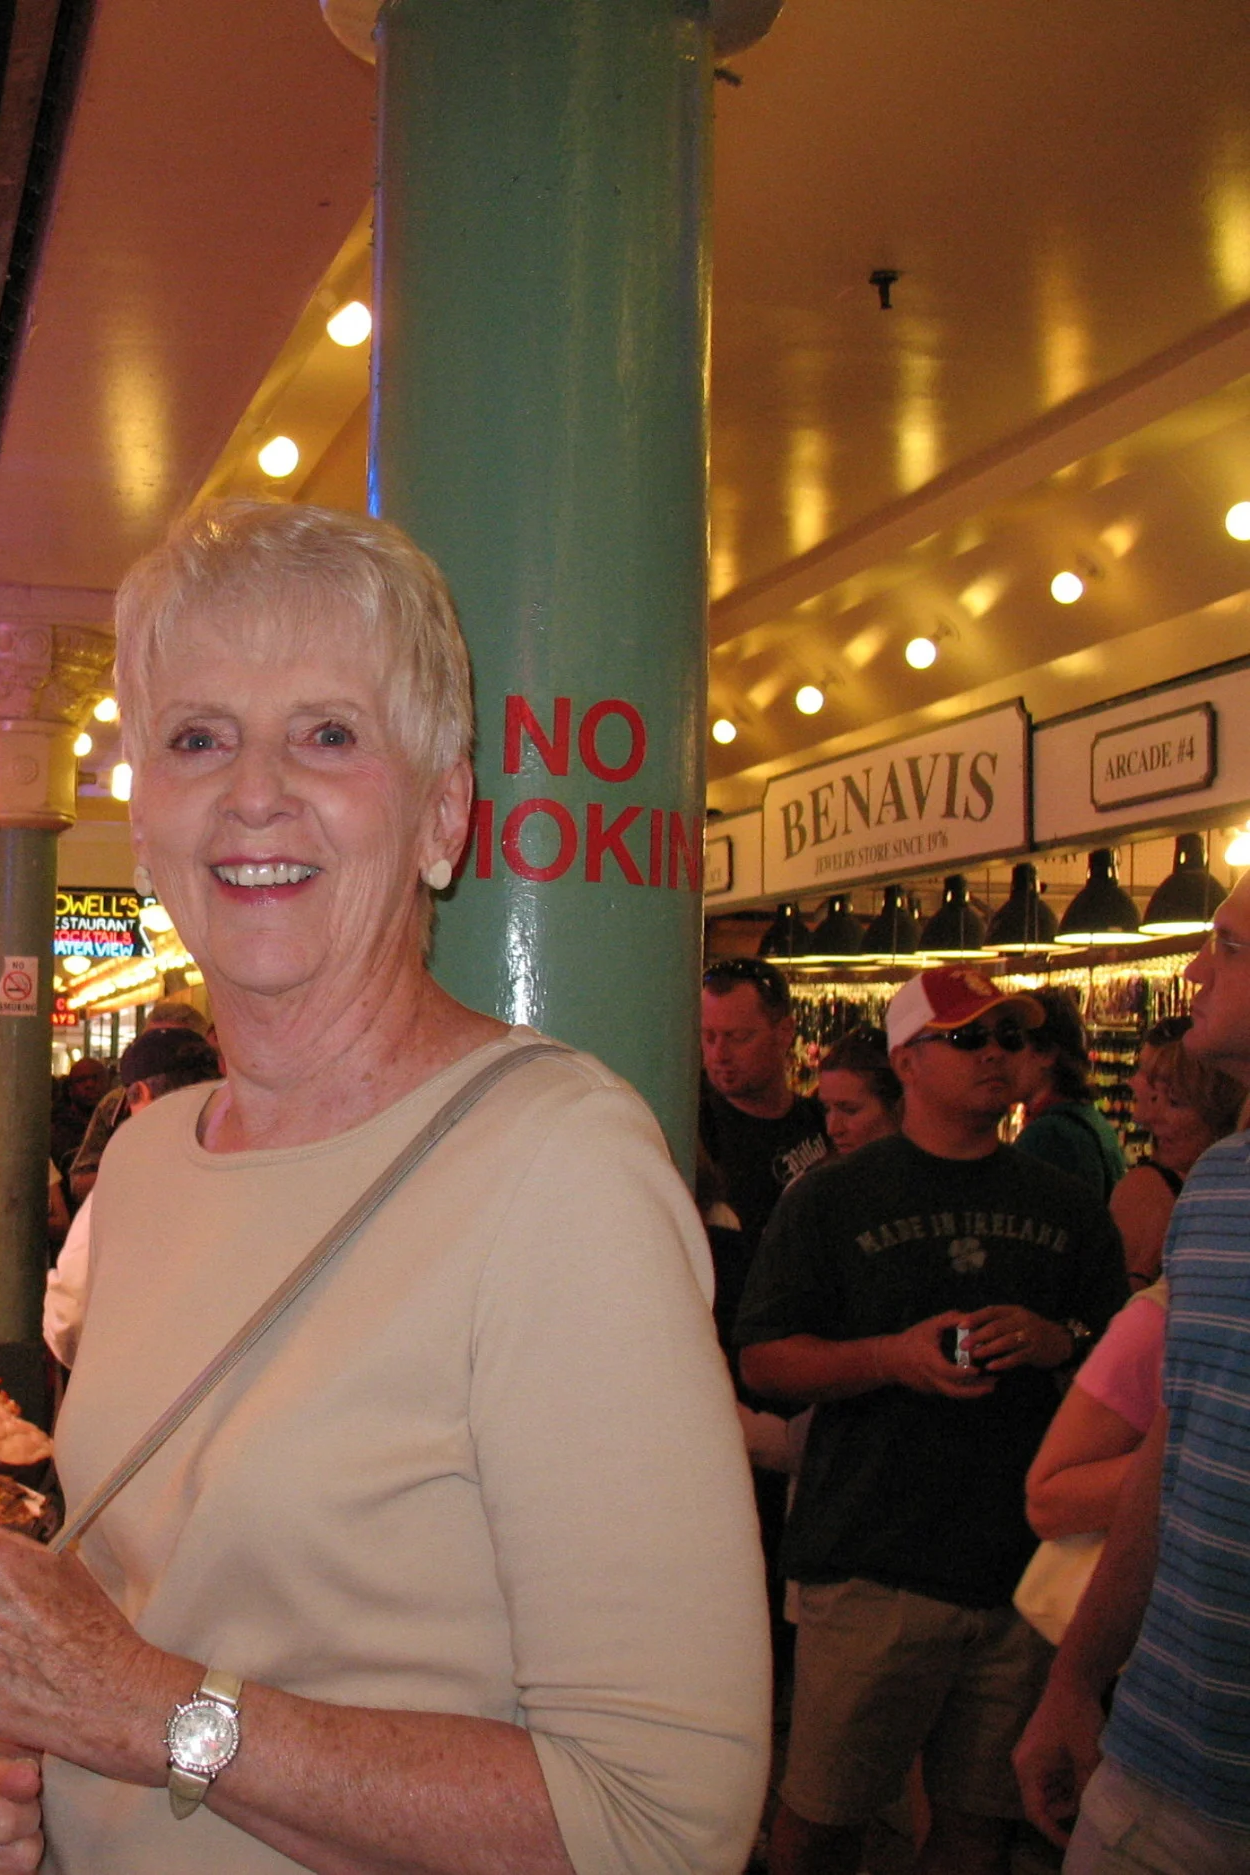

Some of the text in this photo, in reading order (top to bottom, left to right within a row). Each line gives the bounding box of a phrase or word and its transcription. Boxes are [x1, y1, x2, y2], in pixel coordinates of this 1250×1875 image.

[503, 695, 646, 783] NO
[1105, 735, 1196, 783] ARCADE #4
[779, 750, 998, 861] BENAVIS
[815, 851, 857, 877] JEWELRY
[858, 843, 890, 867] STORE
[891, 836, 924, 860] SINCE
[56, 894, 140, 918] OWELL'S
[12, 962, 25, 970] NO
[855, 1212, 1069, 1253] MADE IN IRELAND
